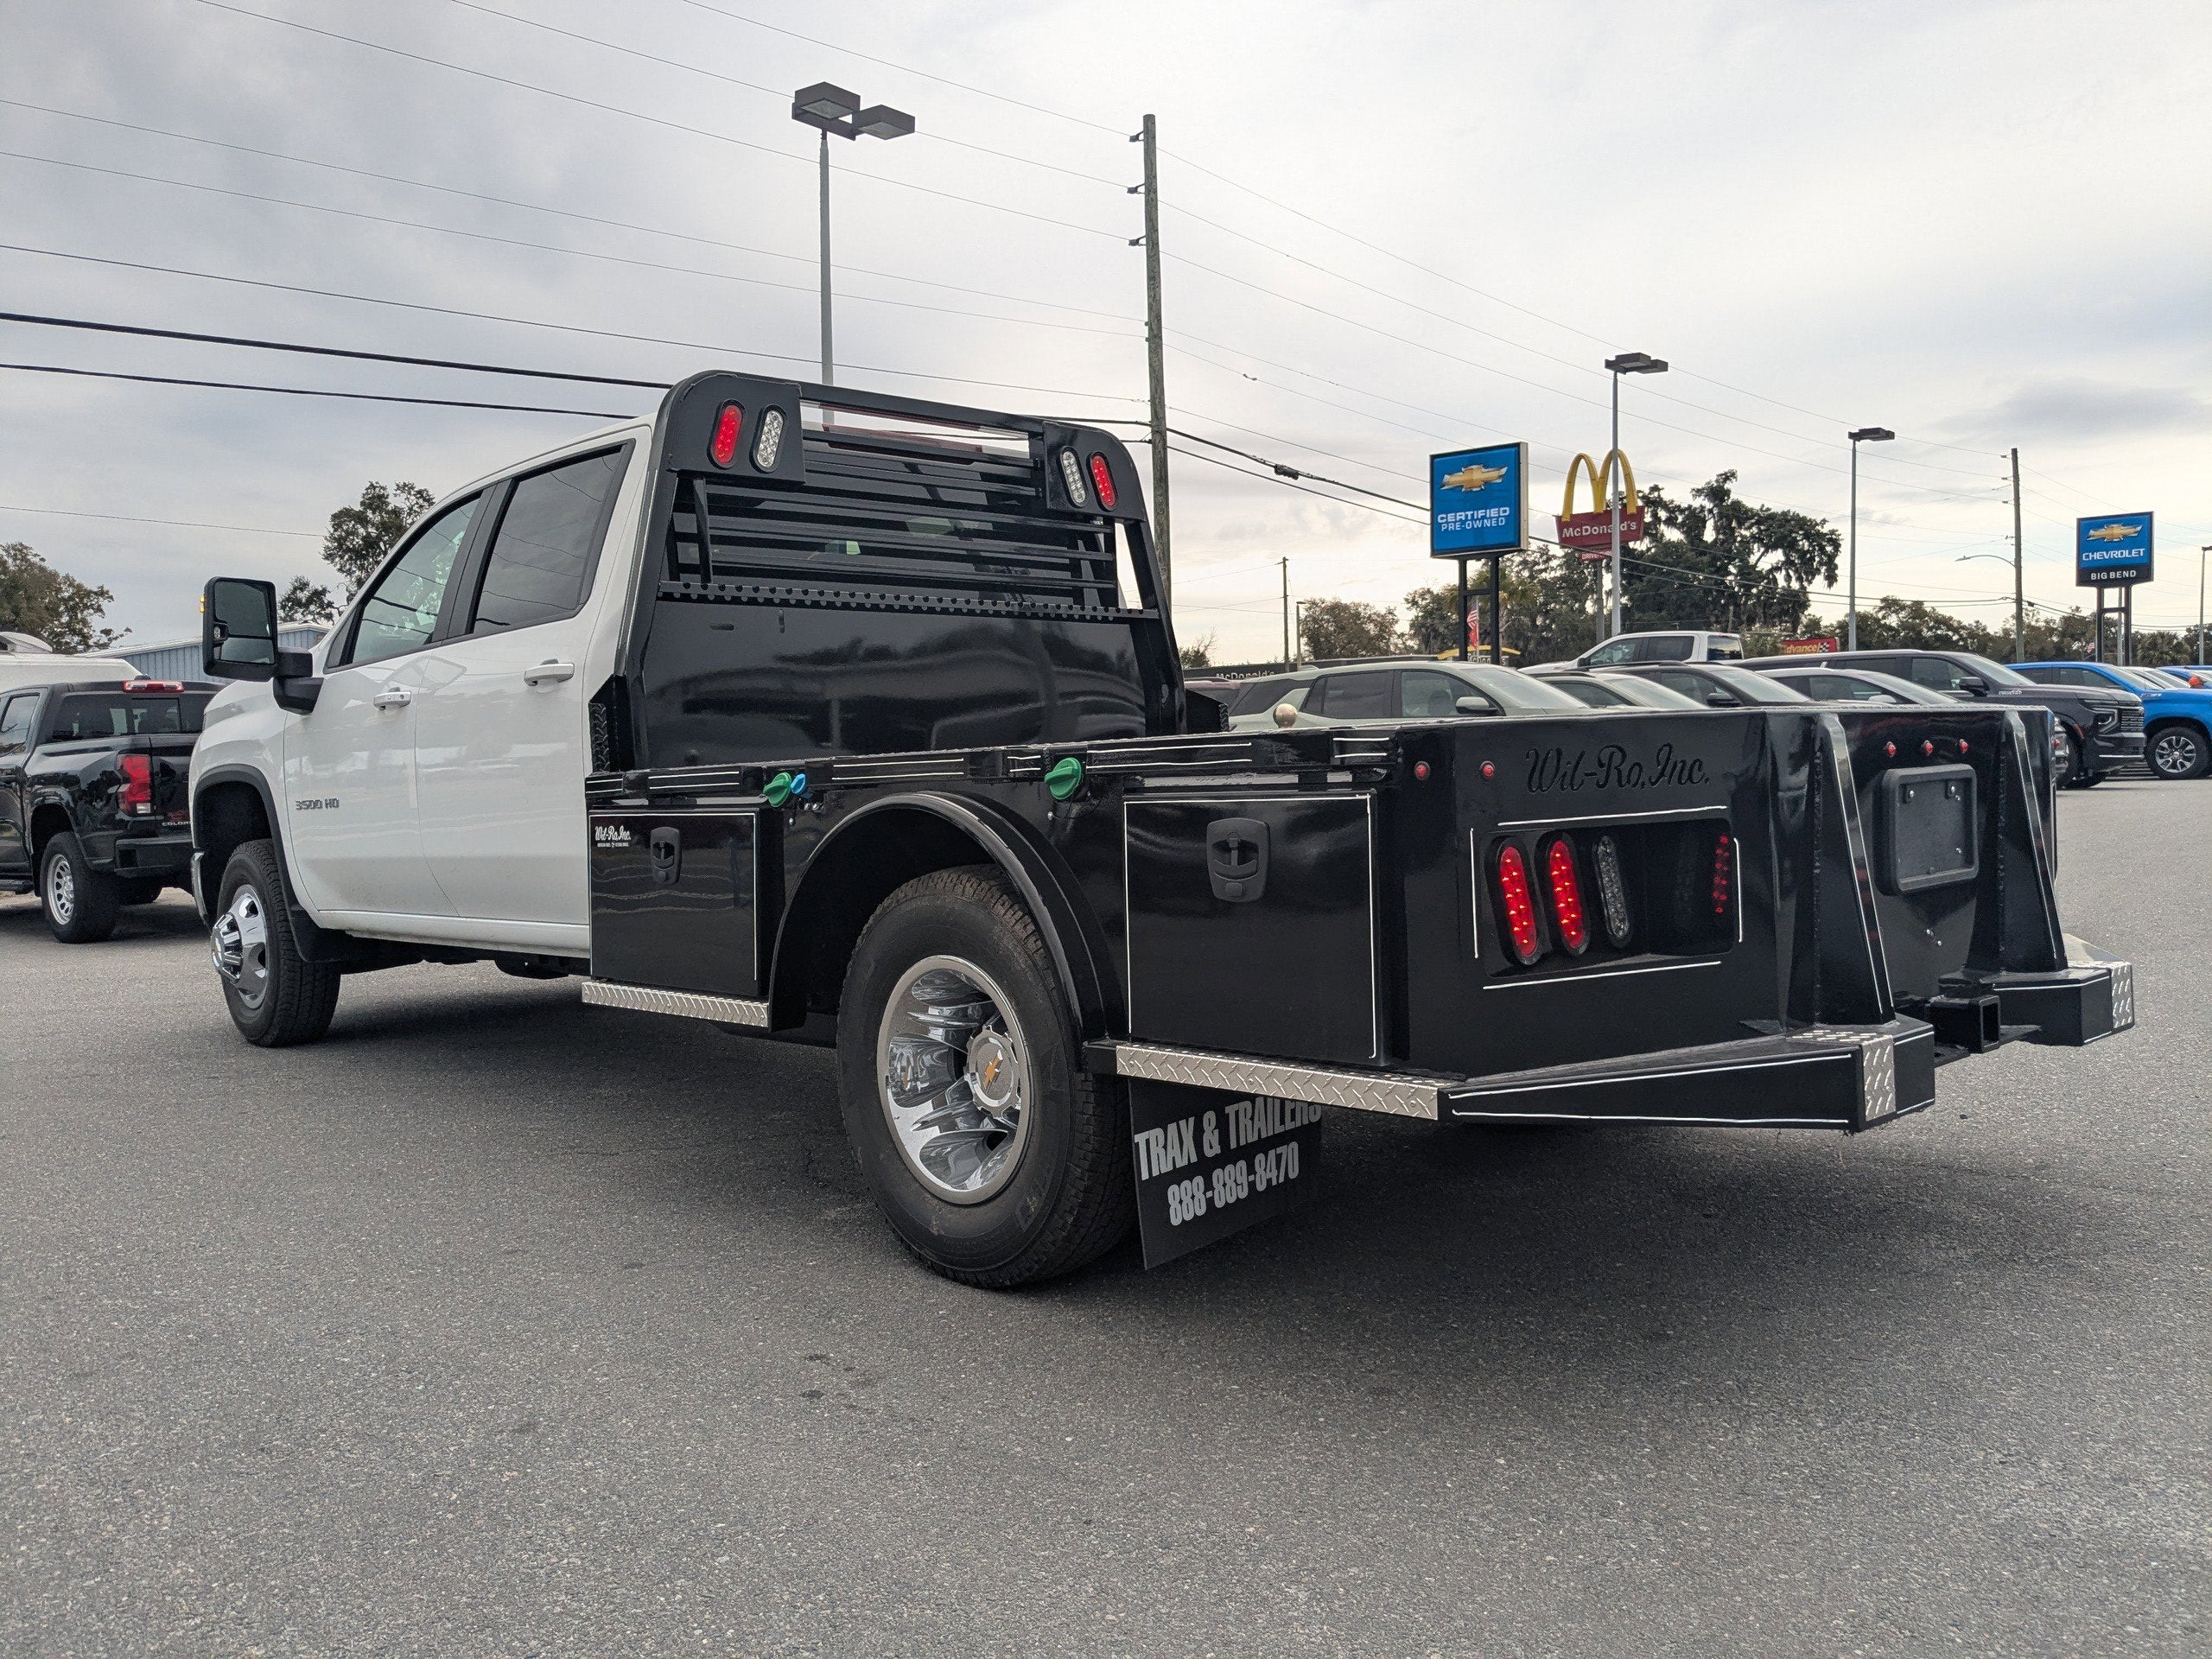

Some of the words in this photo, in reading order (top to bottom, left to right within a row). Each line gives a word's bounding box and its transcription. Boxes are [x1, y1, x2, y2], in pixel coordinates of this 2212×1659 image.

[1437, 506, 1510, 524] CERTIFIED
[1441, 517, 1505, 531] PRE-OWNED
[1561, 521, 1637, 537] McDonad's
[2082, 548, 2145, 561] CHEVROLET
[2091, 572, 2107, 581] BIG
[2109, 570, 2137, 579] BEND
[1785, 644, 1818, 654] dvance
[295, 799, 323, 810] 3500
[324, 798, 340, 809] HD
[1134, 1127, 1198, 1181] TRAX
[1202, 1110, 1222, 1158] &
[1167, 1141, 1300, 1226] 888-889-8470
